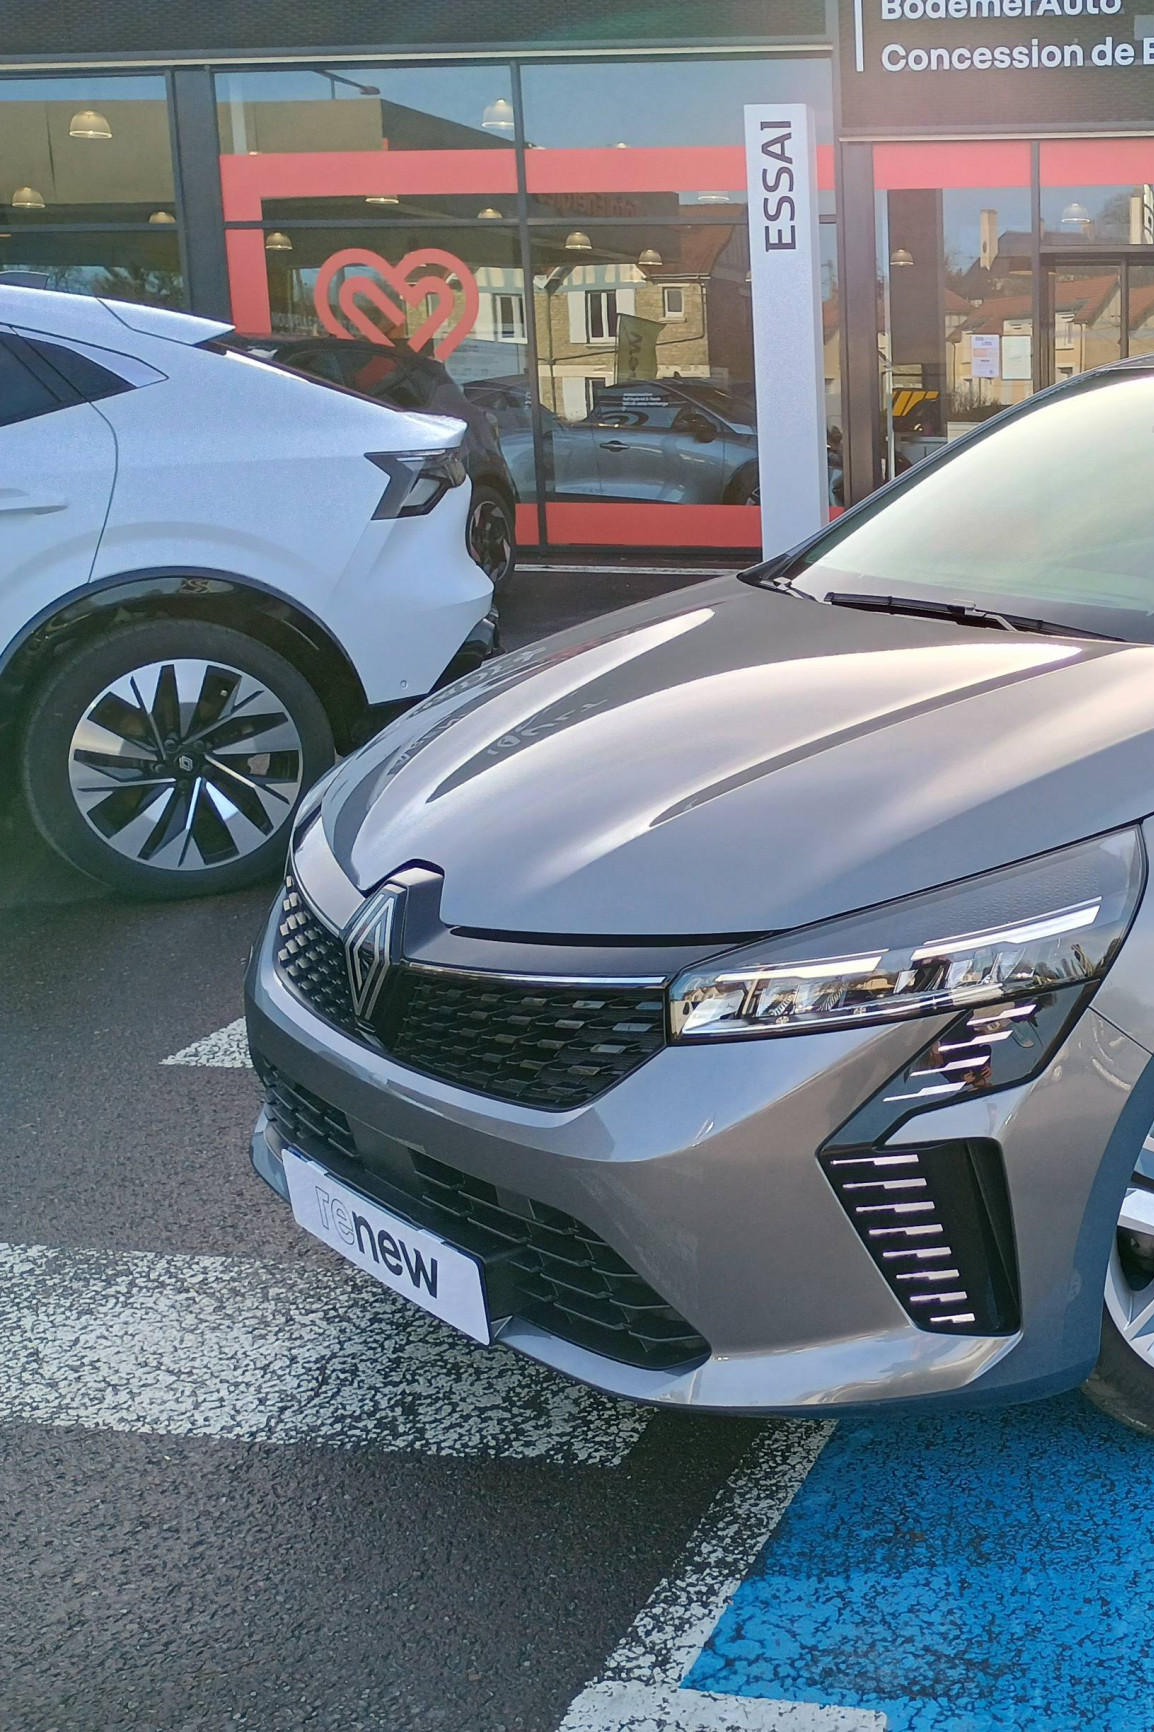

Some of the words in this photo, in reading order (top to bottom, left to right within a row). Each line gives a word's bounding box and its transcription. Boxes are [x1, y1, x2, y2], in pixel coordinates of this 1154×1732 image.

[881, 0, 1121, 20] BodemerAuto
[881, 38, 1083, 72] Concession
[1090, 37, 1135, 66] de
[760, 121, 797, 253] ESSAI
[315, 1185, 438, 1300] renew
